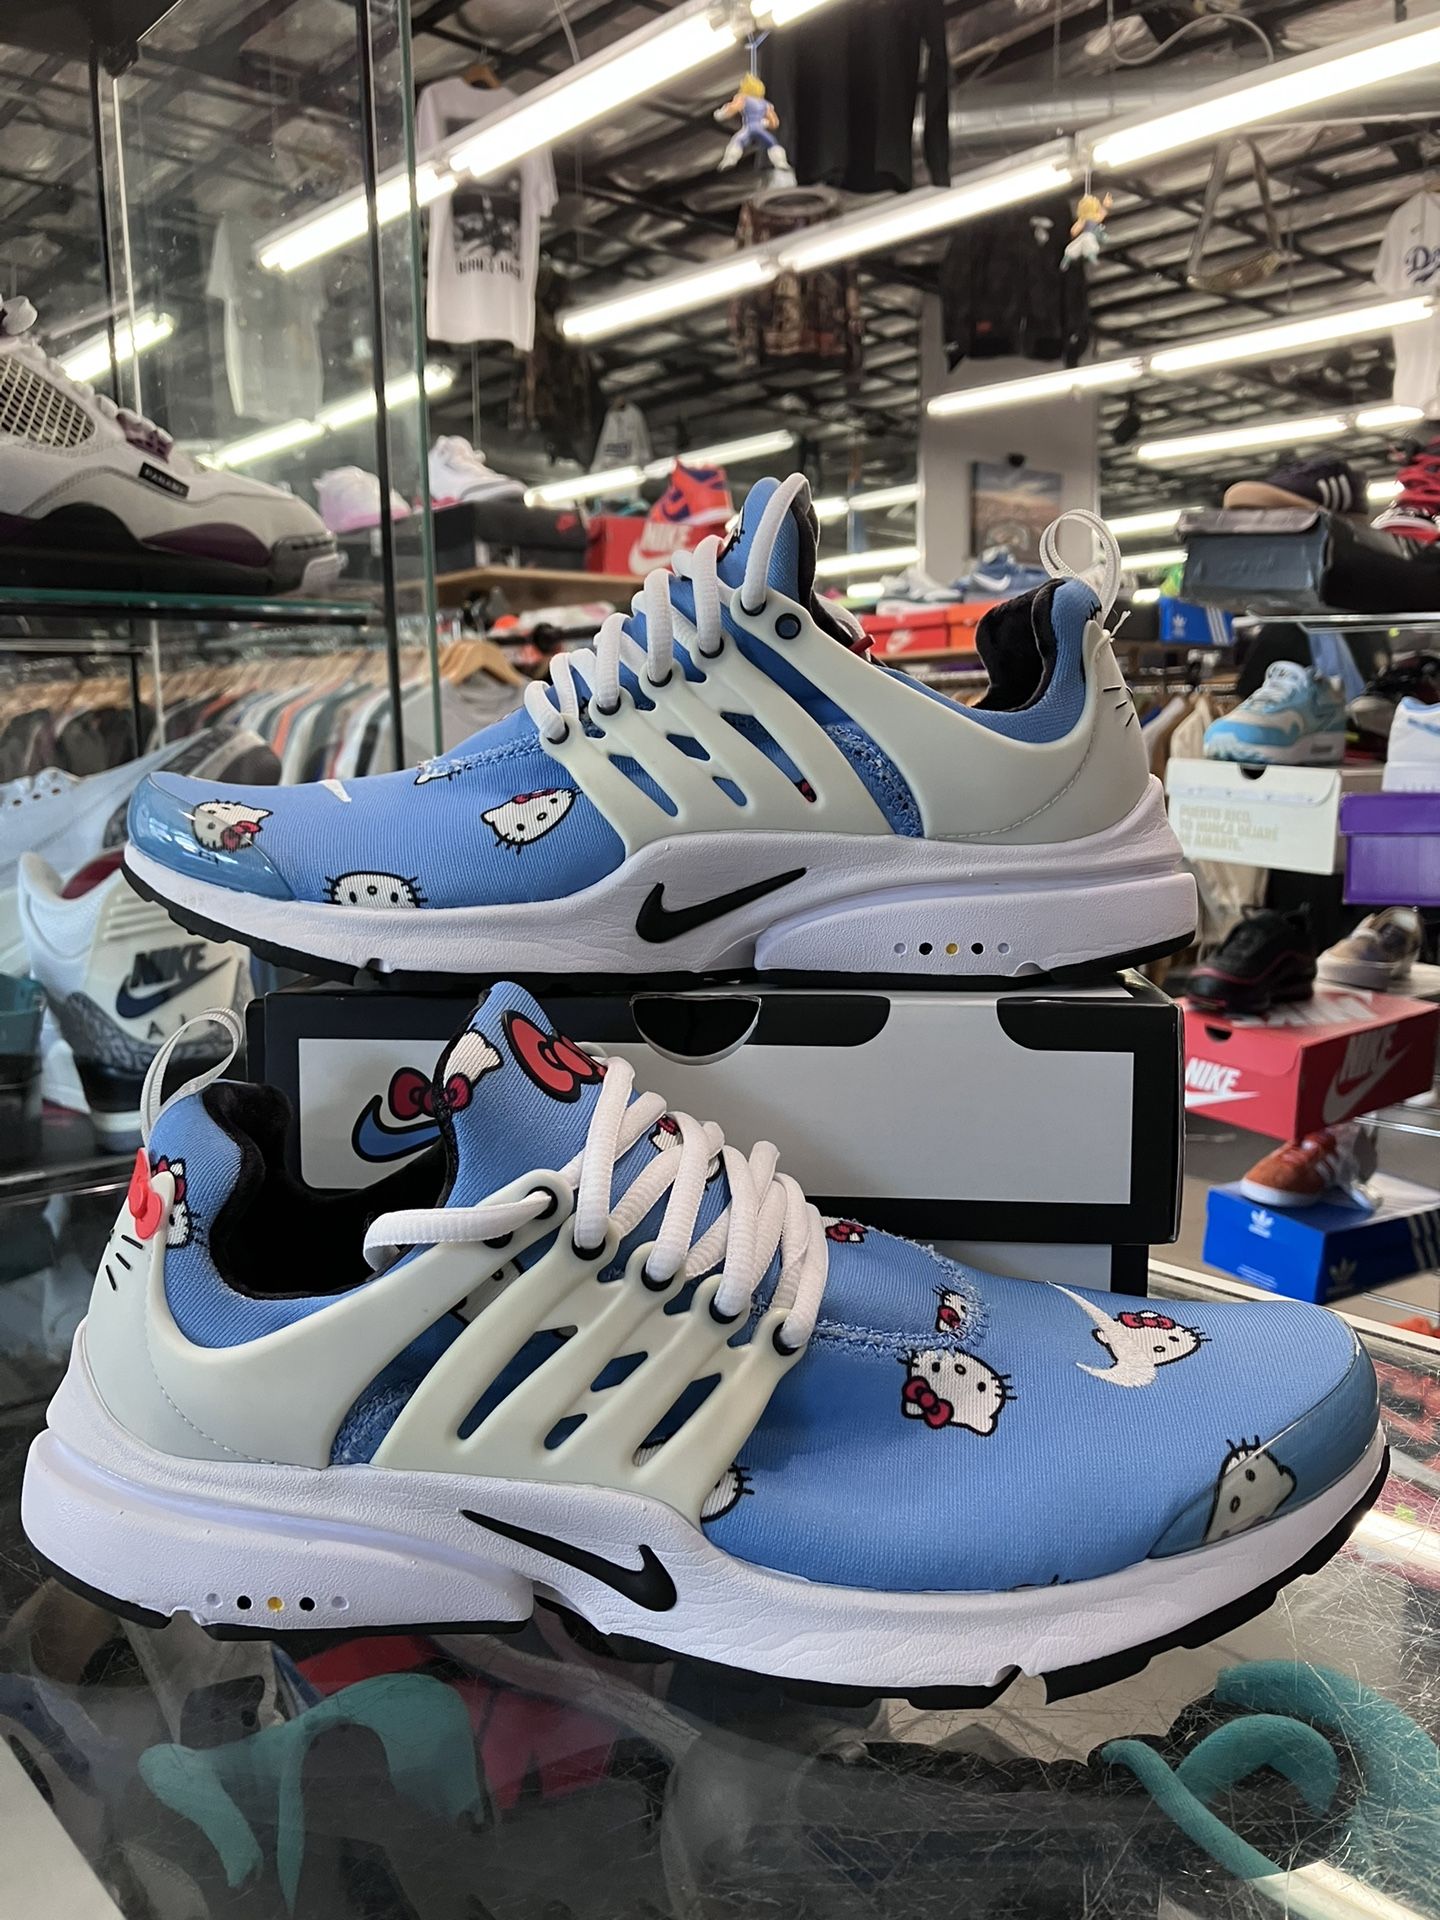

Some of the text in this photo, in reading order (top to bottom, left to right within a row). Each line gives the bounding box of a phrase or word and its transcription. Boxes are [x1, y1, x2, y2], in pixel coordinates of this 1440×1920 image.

[130, 942, 208, 988] NIKE
[1185, 1057, 1241, 1094] NIKE
[1339, 1022, 1398, 1085] NIKE
